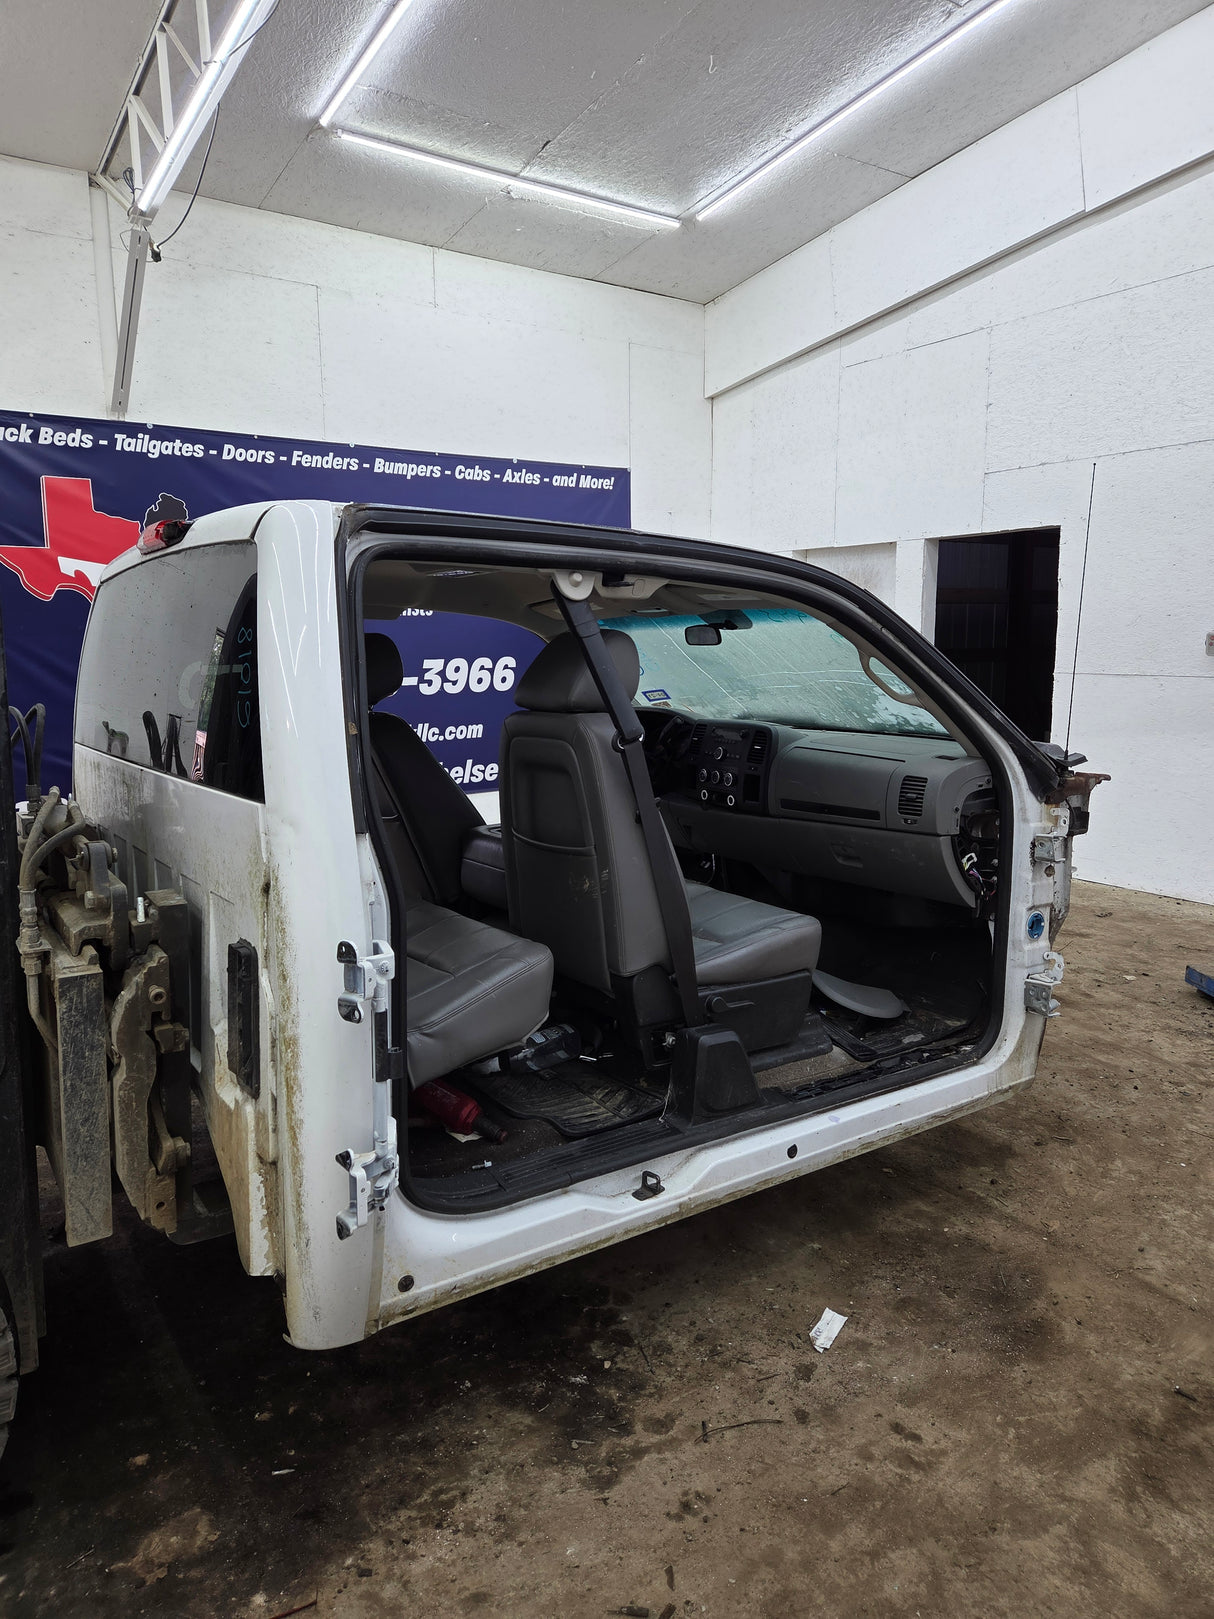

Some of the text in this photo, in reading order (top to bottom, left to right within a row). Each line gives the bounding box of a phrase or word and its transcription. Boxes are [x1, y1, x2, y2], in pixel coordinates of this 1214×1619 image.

[38, 427, 93, 449] Beds
[114, 433, 205, 459] Tailgates
[222, 444, 275, 464] Doors
[291, 450, 360, 471] Fenders
[374, 458, 442, 480] Bumpers
[454, 465, 492, 482] Cabs
[503, 469, 541, 486] Axles
[552, 472, 577, 488] and
[578, 475, 615, 491] More!
[402, 656, 517, 696] -3966
[410, 723, 484, 743] llc.com
[439, 759, 499, 785] else
